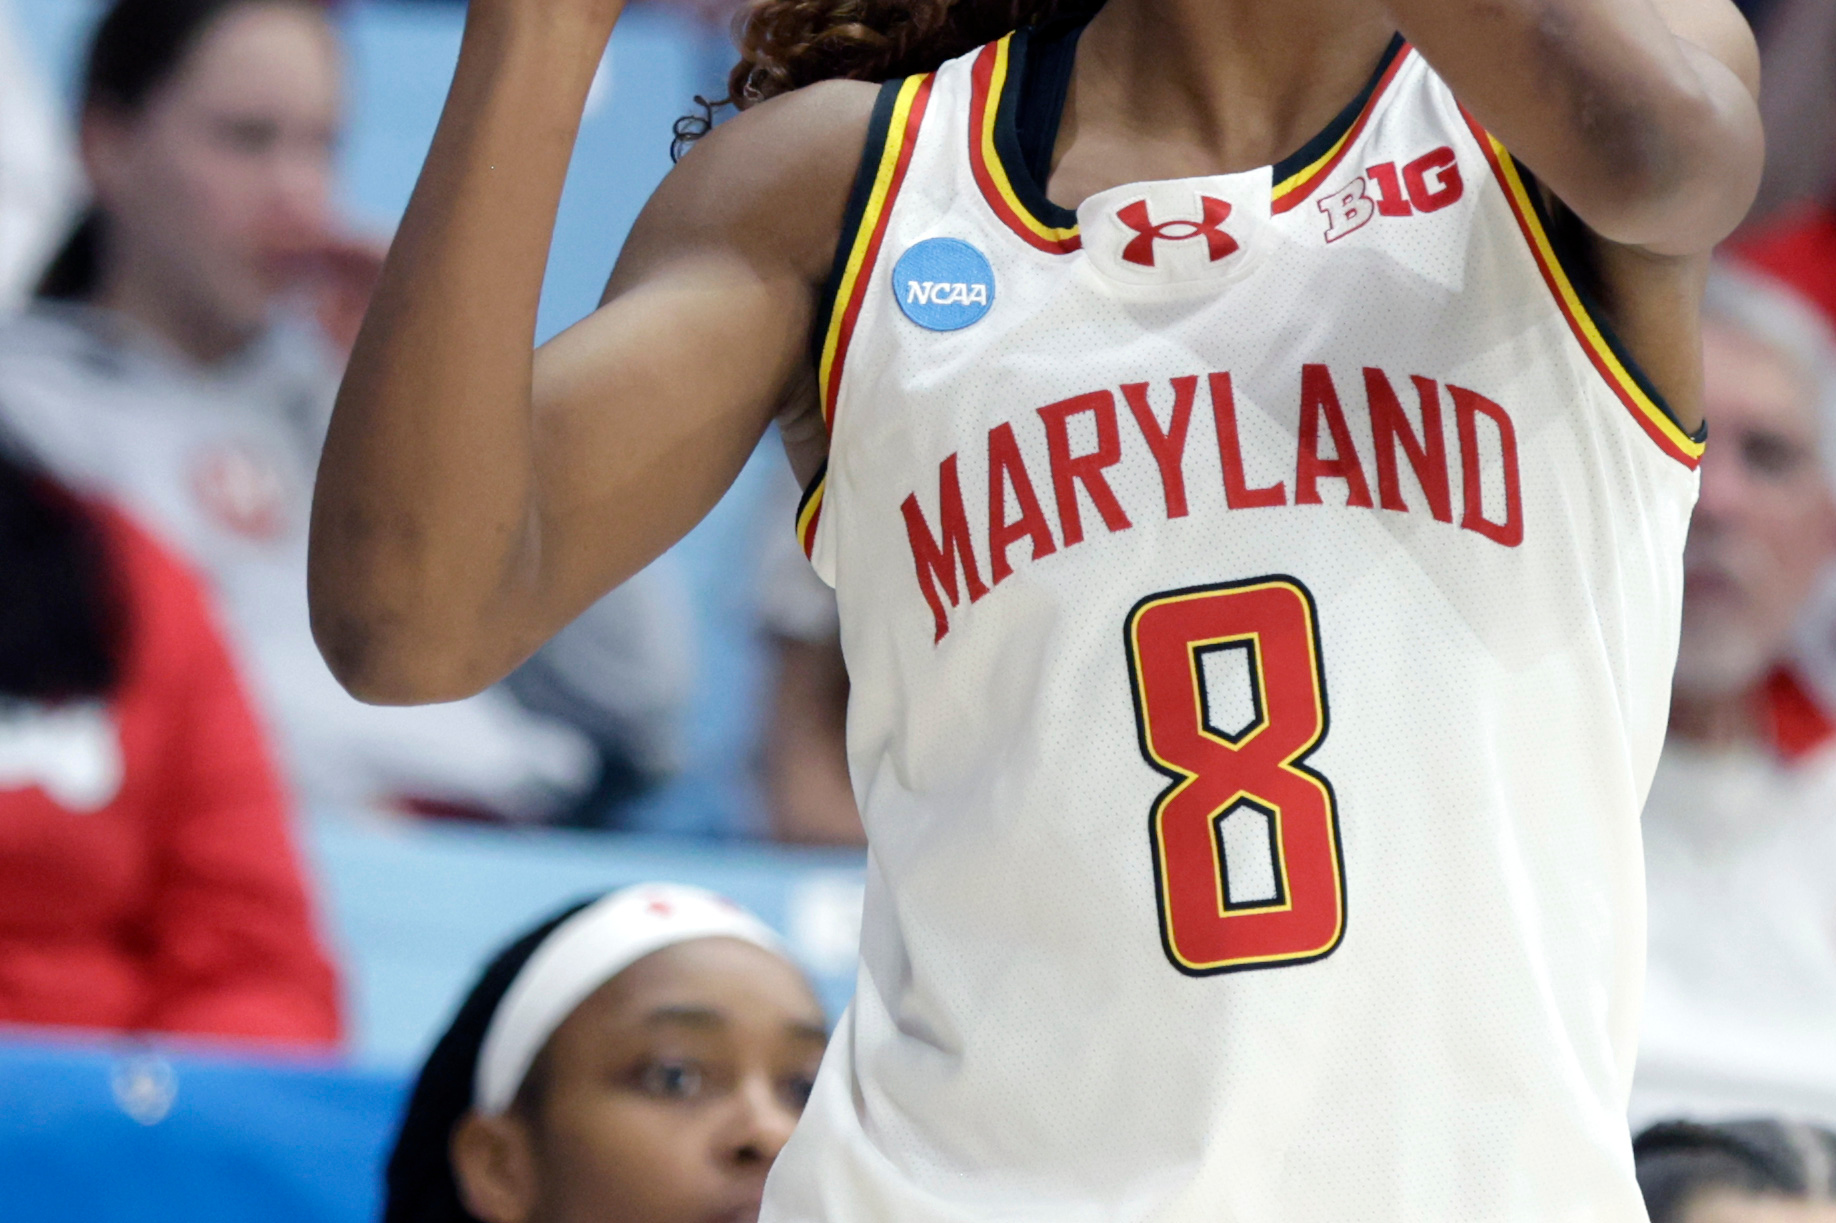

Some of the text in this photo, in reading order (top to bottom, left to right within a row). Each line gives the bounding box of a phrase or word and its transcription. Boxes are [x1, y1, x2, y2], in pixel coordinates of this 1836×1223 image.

[906, 280, 988, 307] NCAA
[900, 363, 1525, 648] MARYLAND
[1123, 573, 1348, 978] 8
